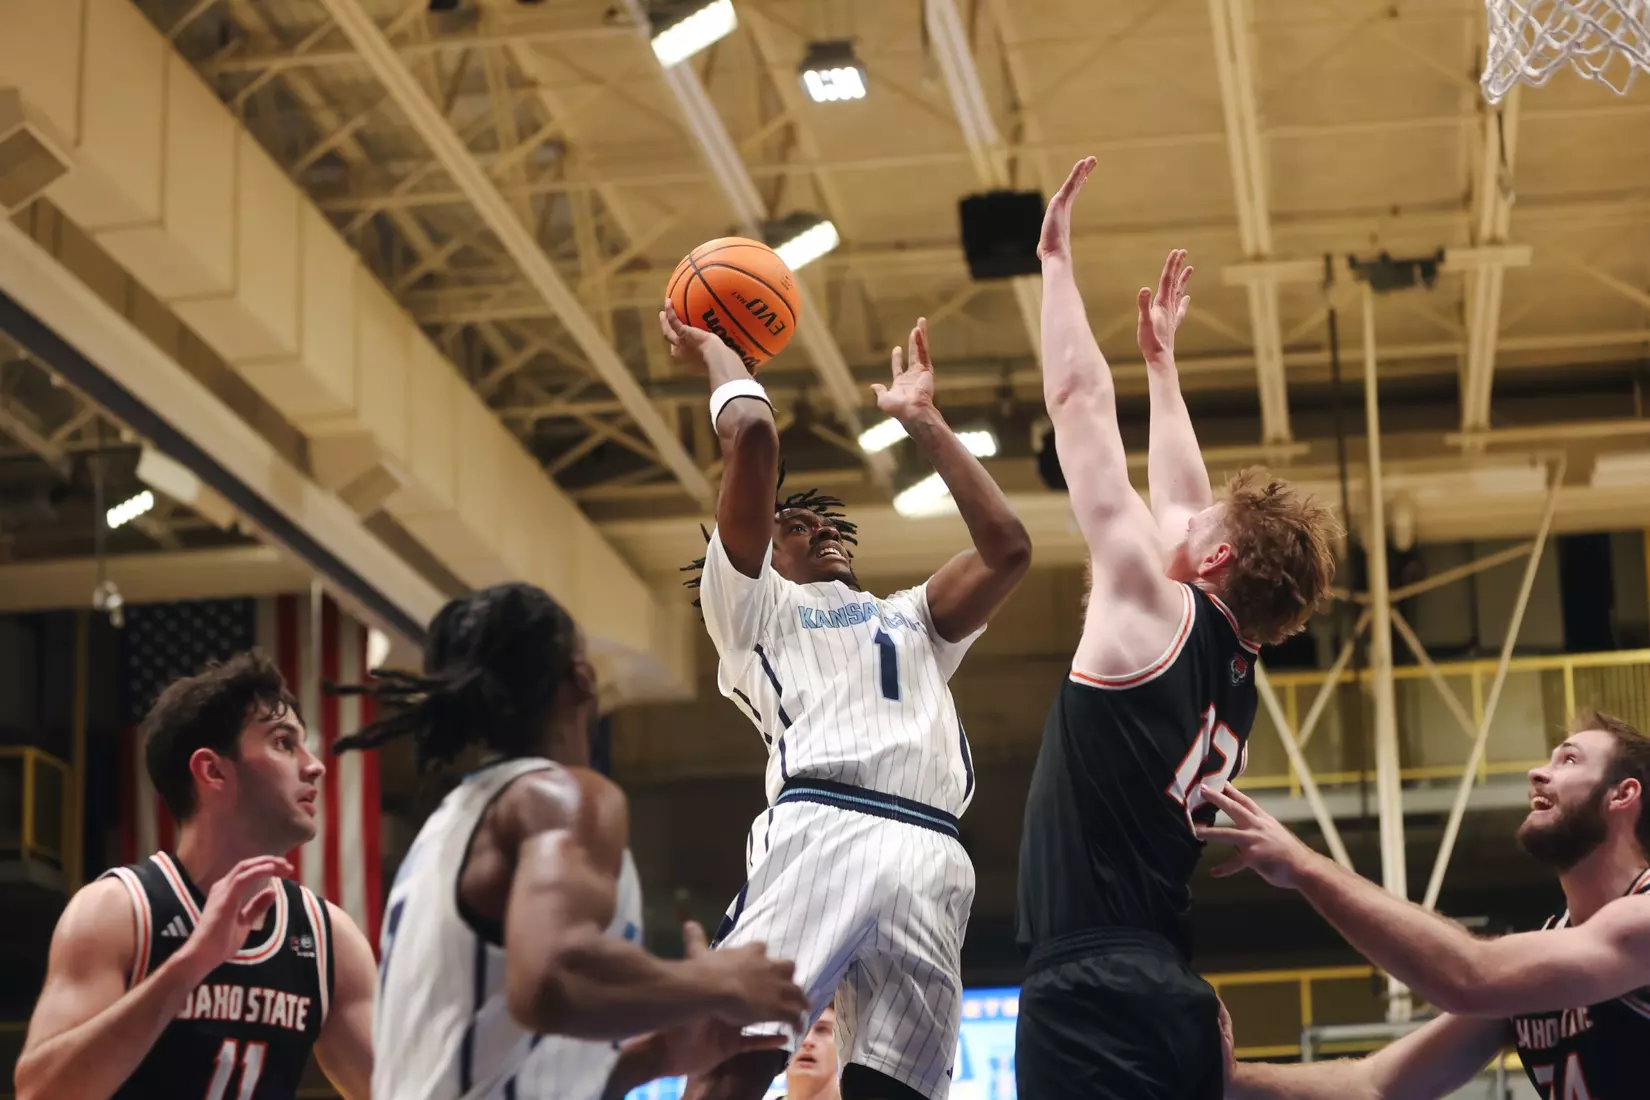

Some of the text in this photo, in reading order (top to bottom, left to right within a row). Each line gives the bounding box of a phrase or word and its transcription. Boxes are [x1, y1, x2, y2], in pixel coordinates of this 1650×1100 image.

[745, 298, 785, 336] EVO
[798, 602, 881, 629] KANSA
[873, 626, 902, 702] 1
[1165, 702, 1240, 842] 12
[245, 987, 311, 1032] STATE
[203, 1037, 269, 1100] 11
